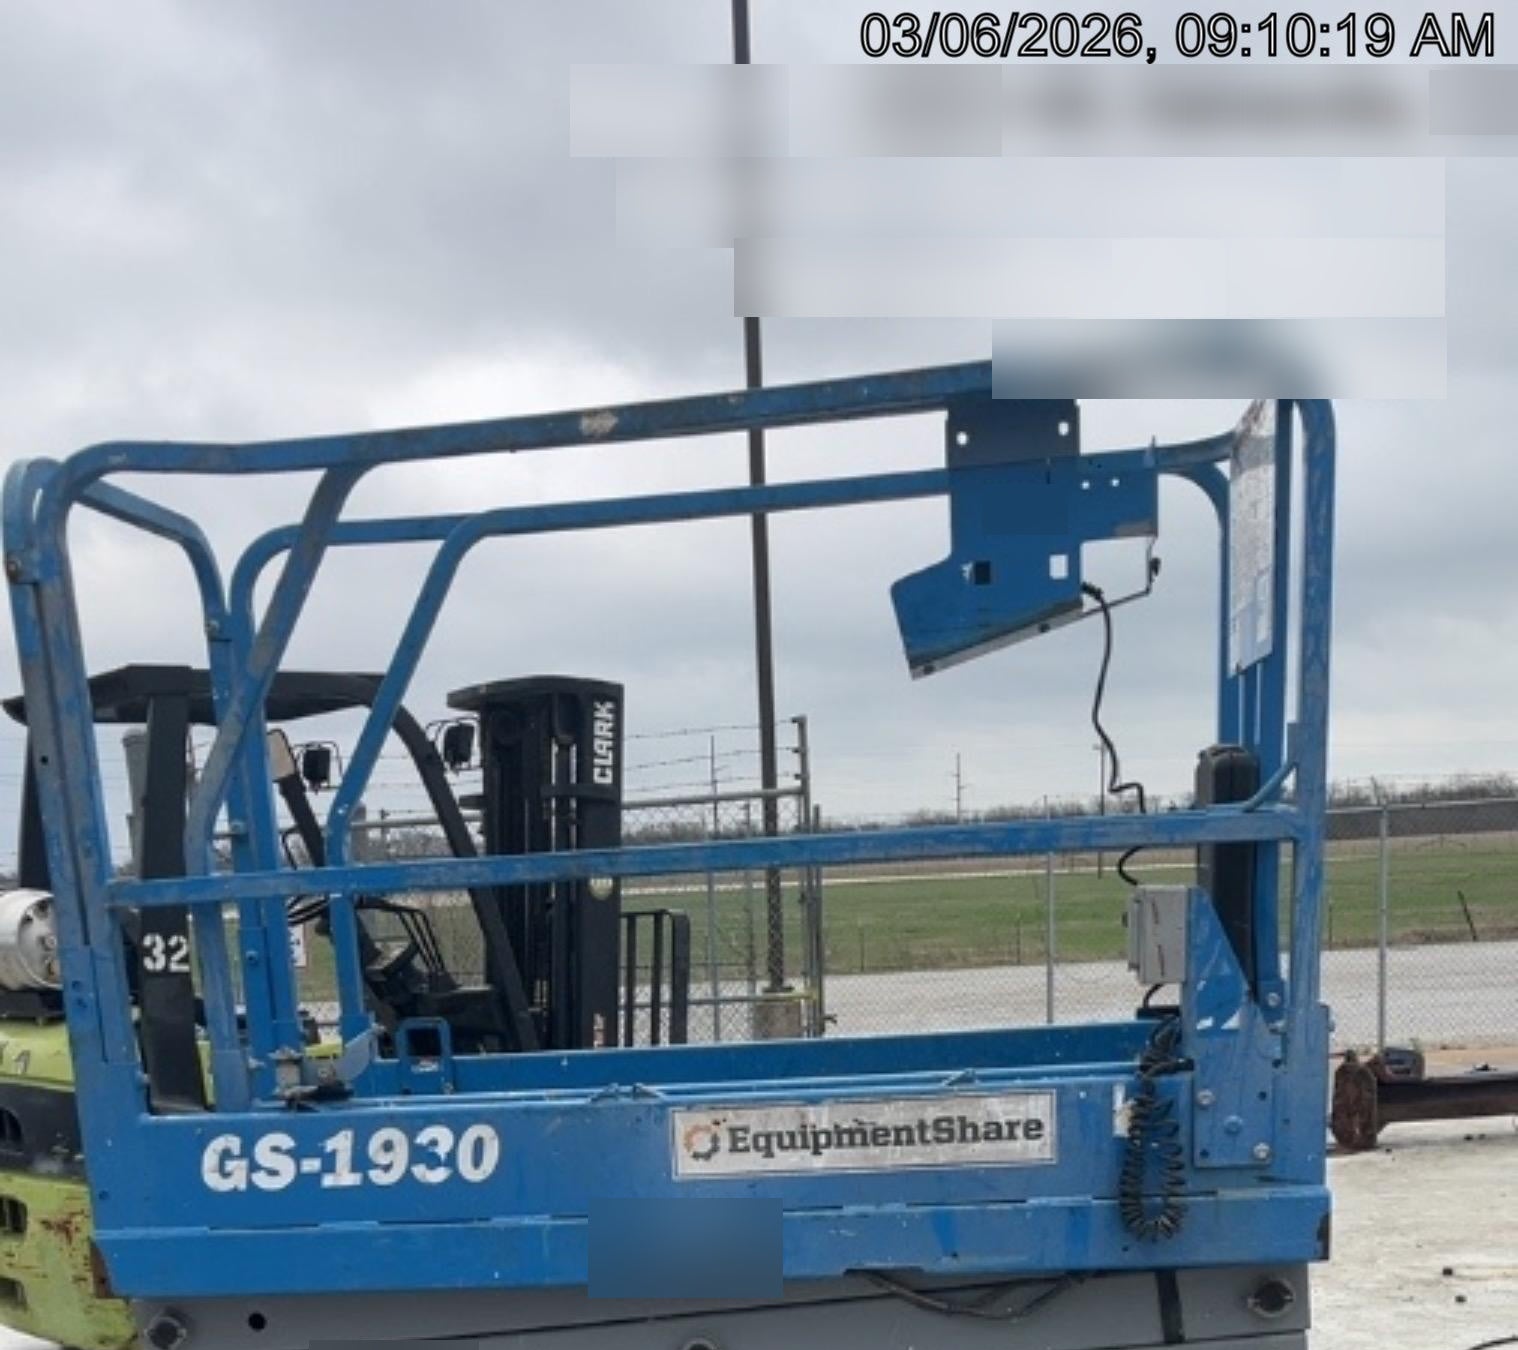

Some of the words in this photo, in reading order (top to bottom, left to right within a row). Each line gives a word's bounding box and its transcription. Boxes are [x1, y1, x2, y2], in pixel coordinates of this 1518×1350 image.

[592, 701, 615, 784] CLARK
[143, 933, 190, 973] 32
[202, 1124, 499, 1191] GS-1930
[728, 1115, 1044, 1158] EquipmentShare
